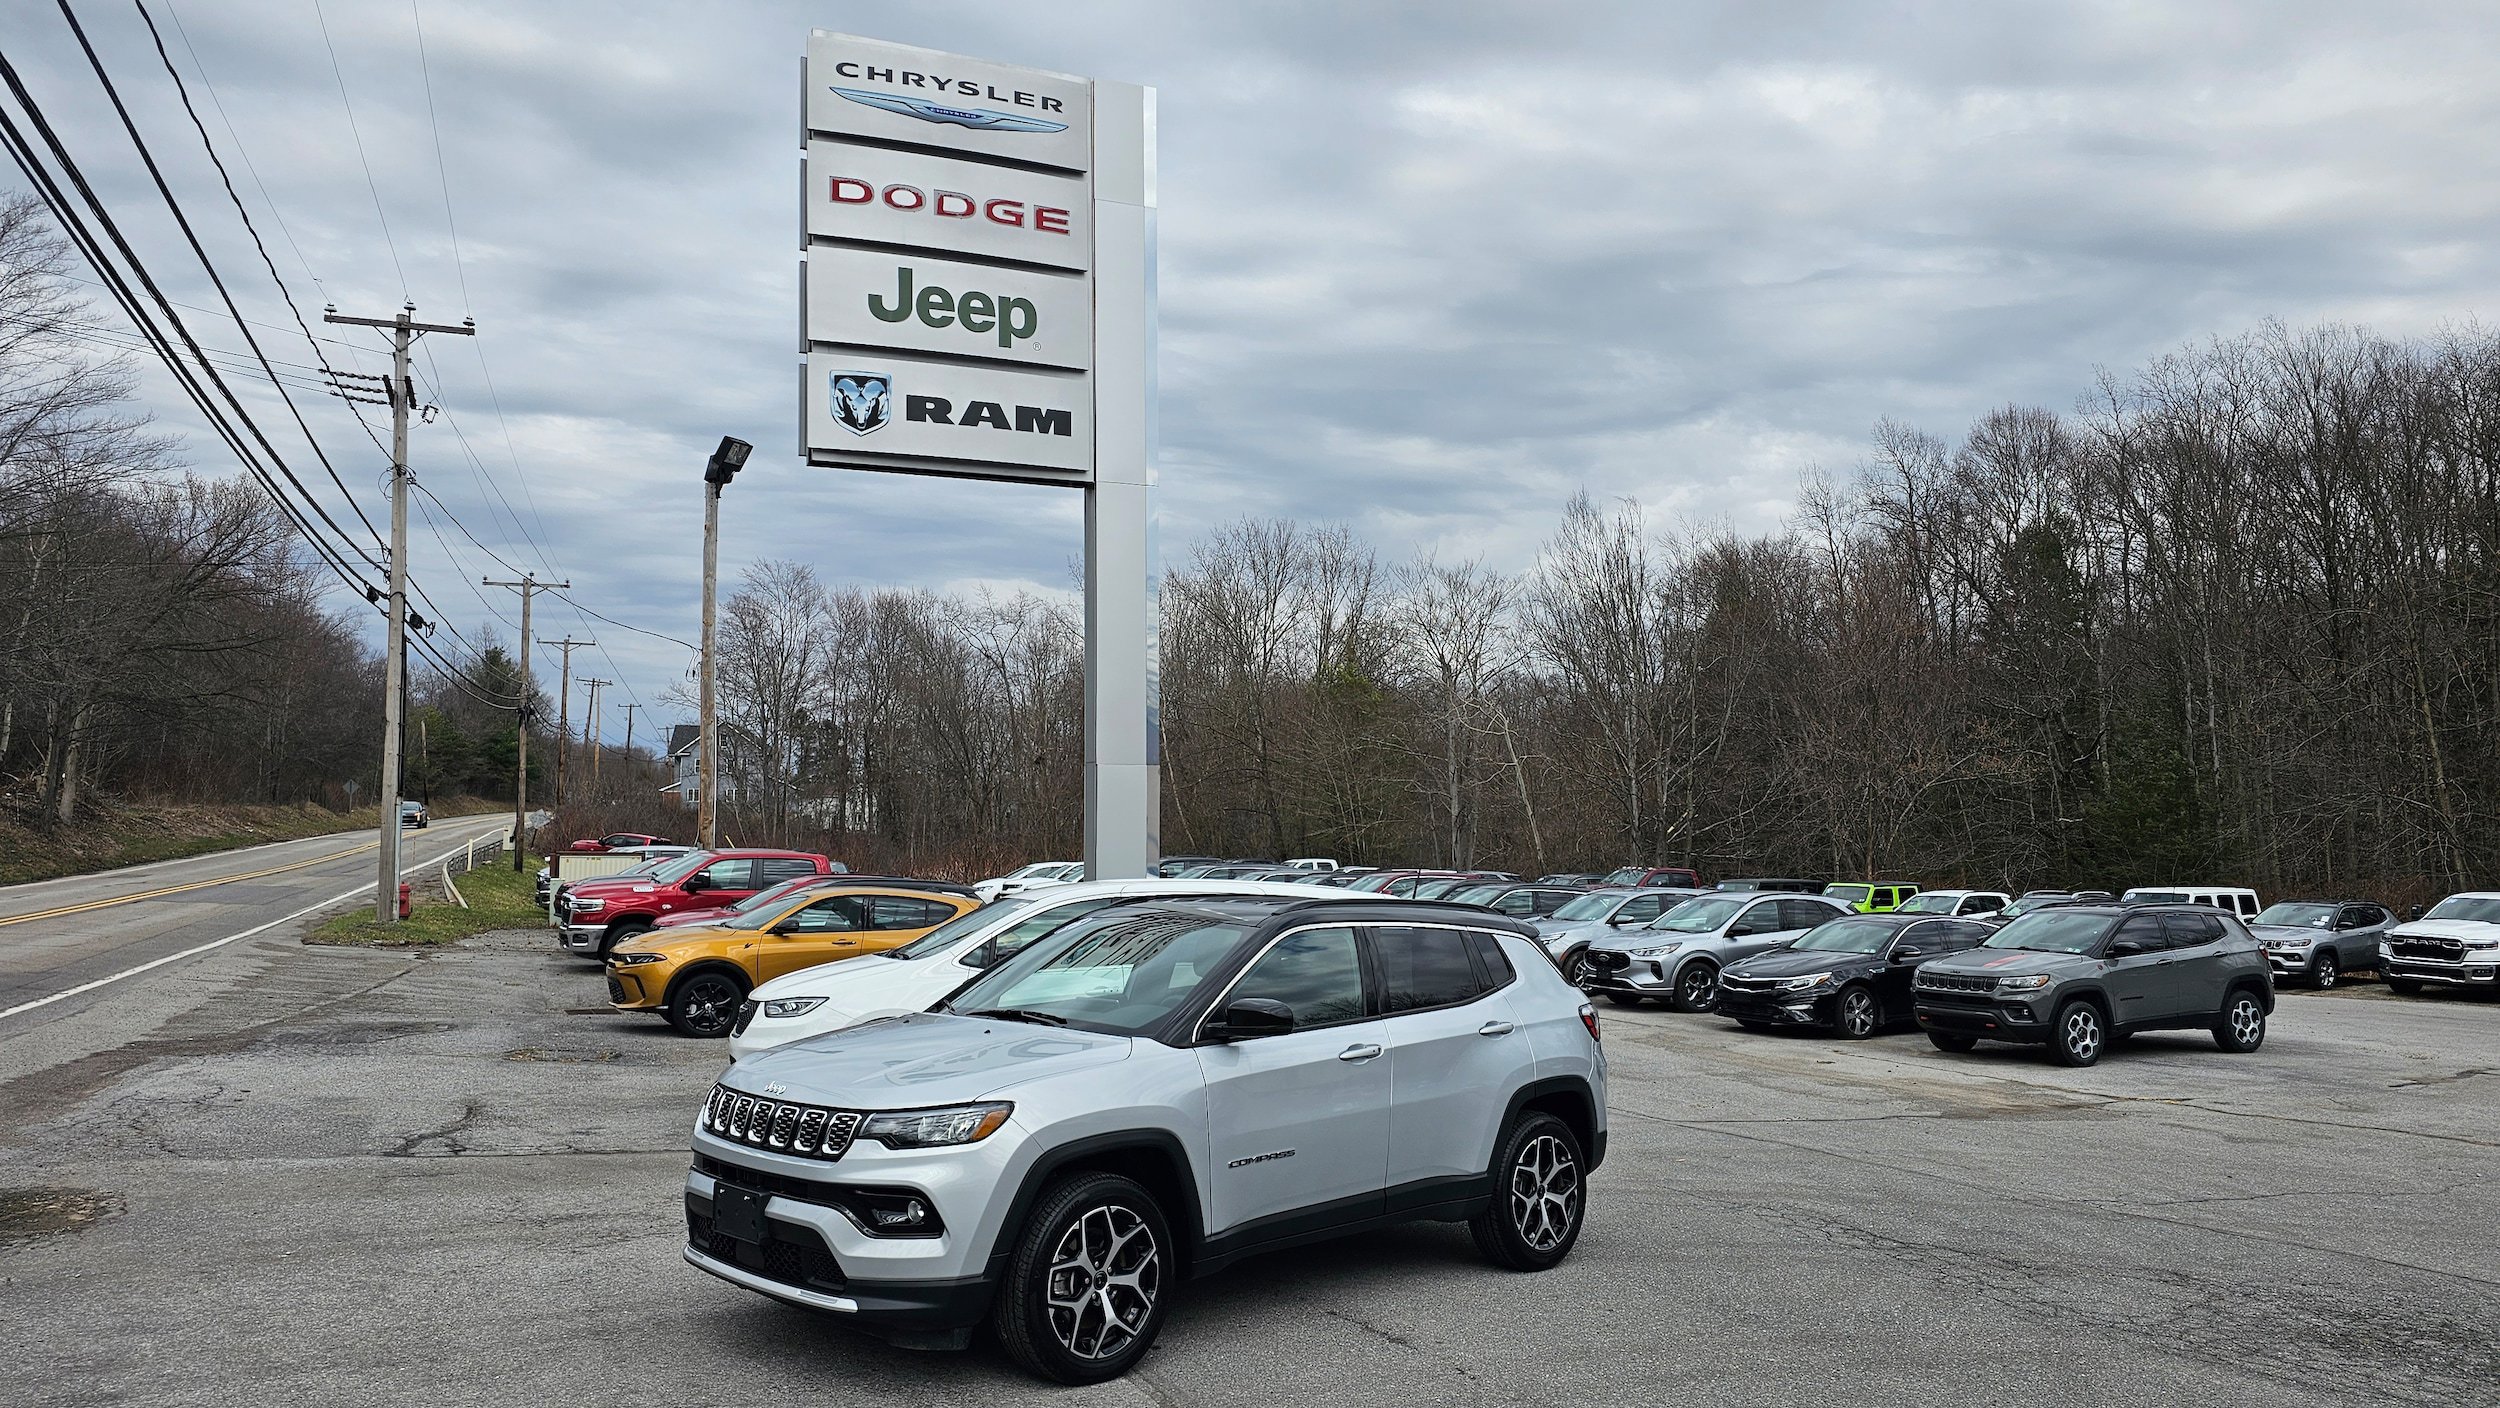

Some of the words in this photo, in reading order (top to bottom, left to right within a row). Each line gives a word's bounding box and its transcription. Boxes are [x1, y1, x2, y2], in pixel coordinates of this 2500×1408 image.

[835, 62, 1064, 114] CHRYSLER
[830, 176, 1071, 235] DODGE
[867, 266, 1038, 349] Jeep
[905, 394, 1073, 437] RAM
[1228, 1148, 1296, 1169] COMPASS
